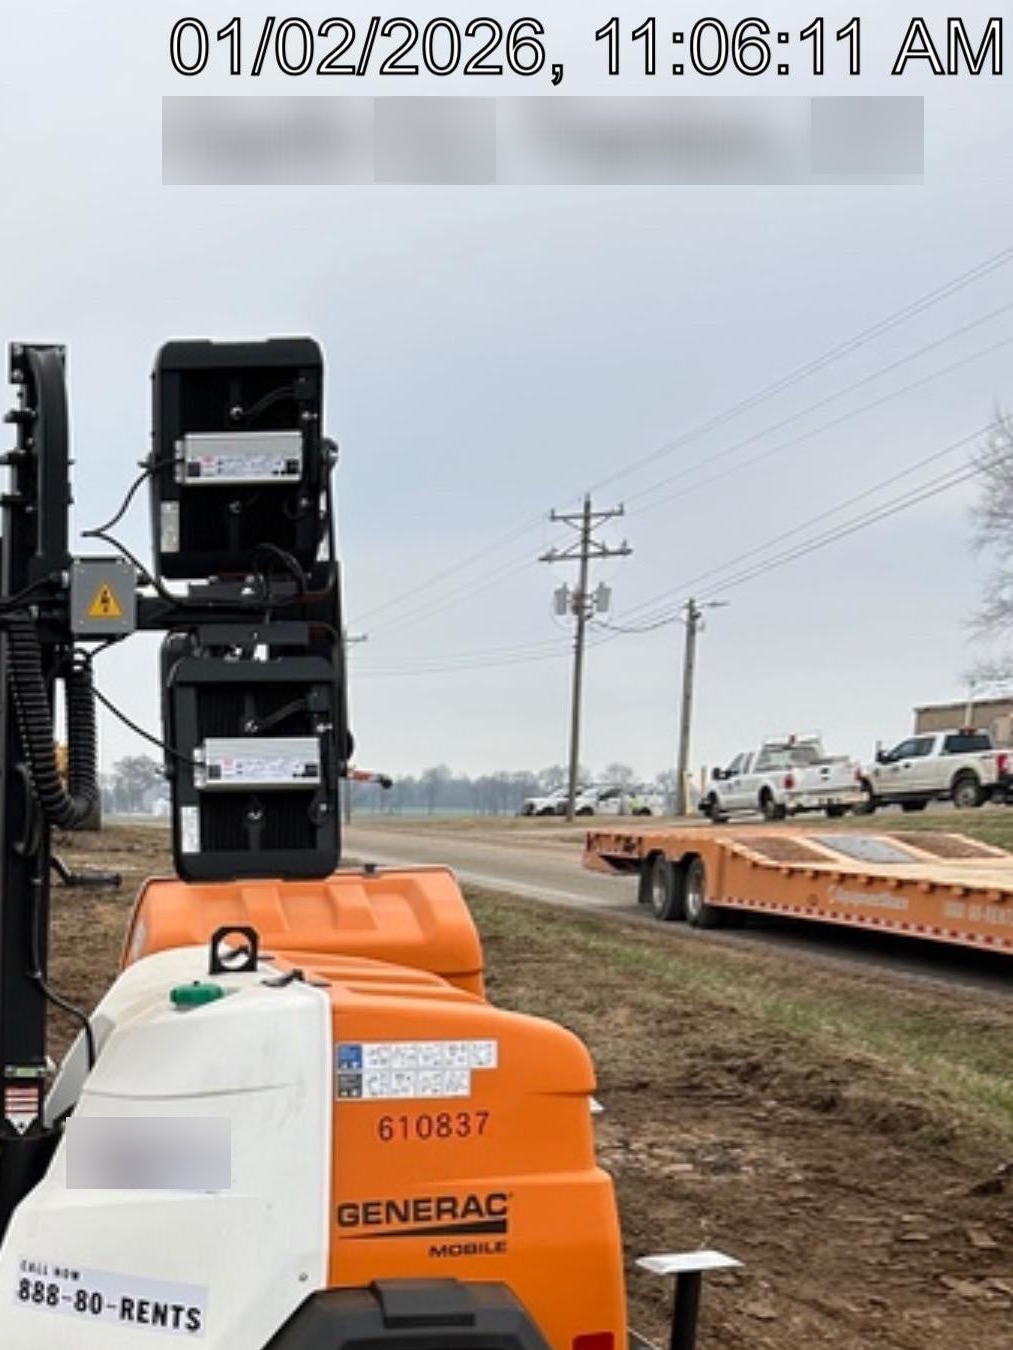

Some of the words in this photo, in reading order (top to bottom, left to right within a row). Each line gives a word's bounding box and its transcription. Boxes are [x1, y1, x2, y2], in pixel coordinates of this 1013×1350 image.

[378, 1111, 490, 1141] 610837
[337, 1193, 508, 1228] GENERAC
[428, 1241, 507, 1258] MOBILE
[18, 1277, 201, 1332] 888-80-RENTS
